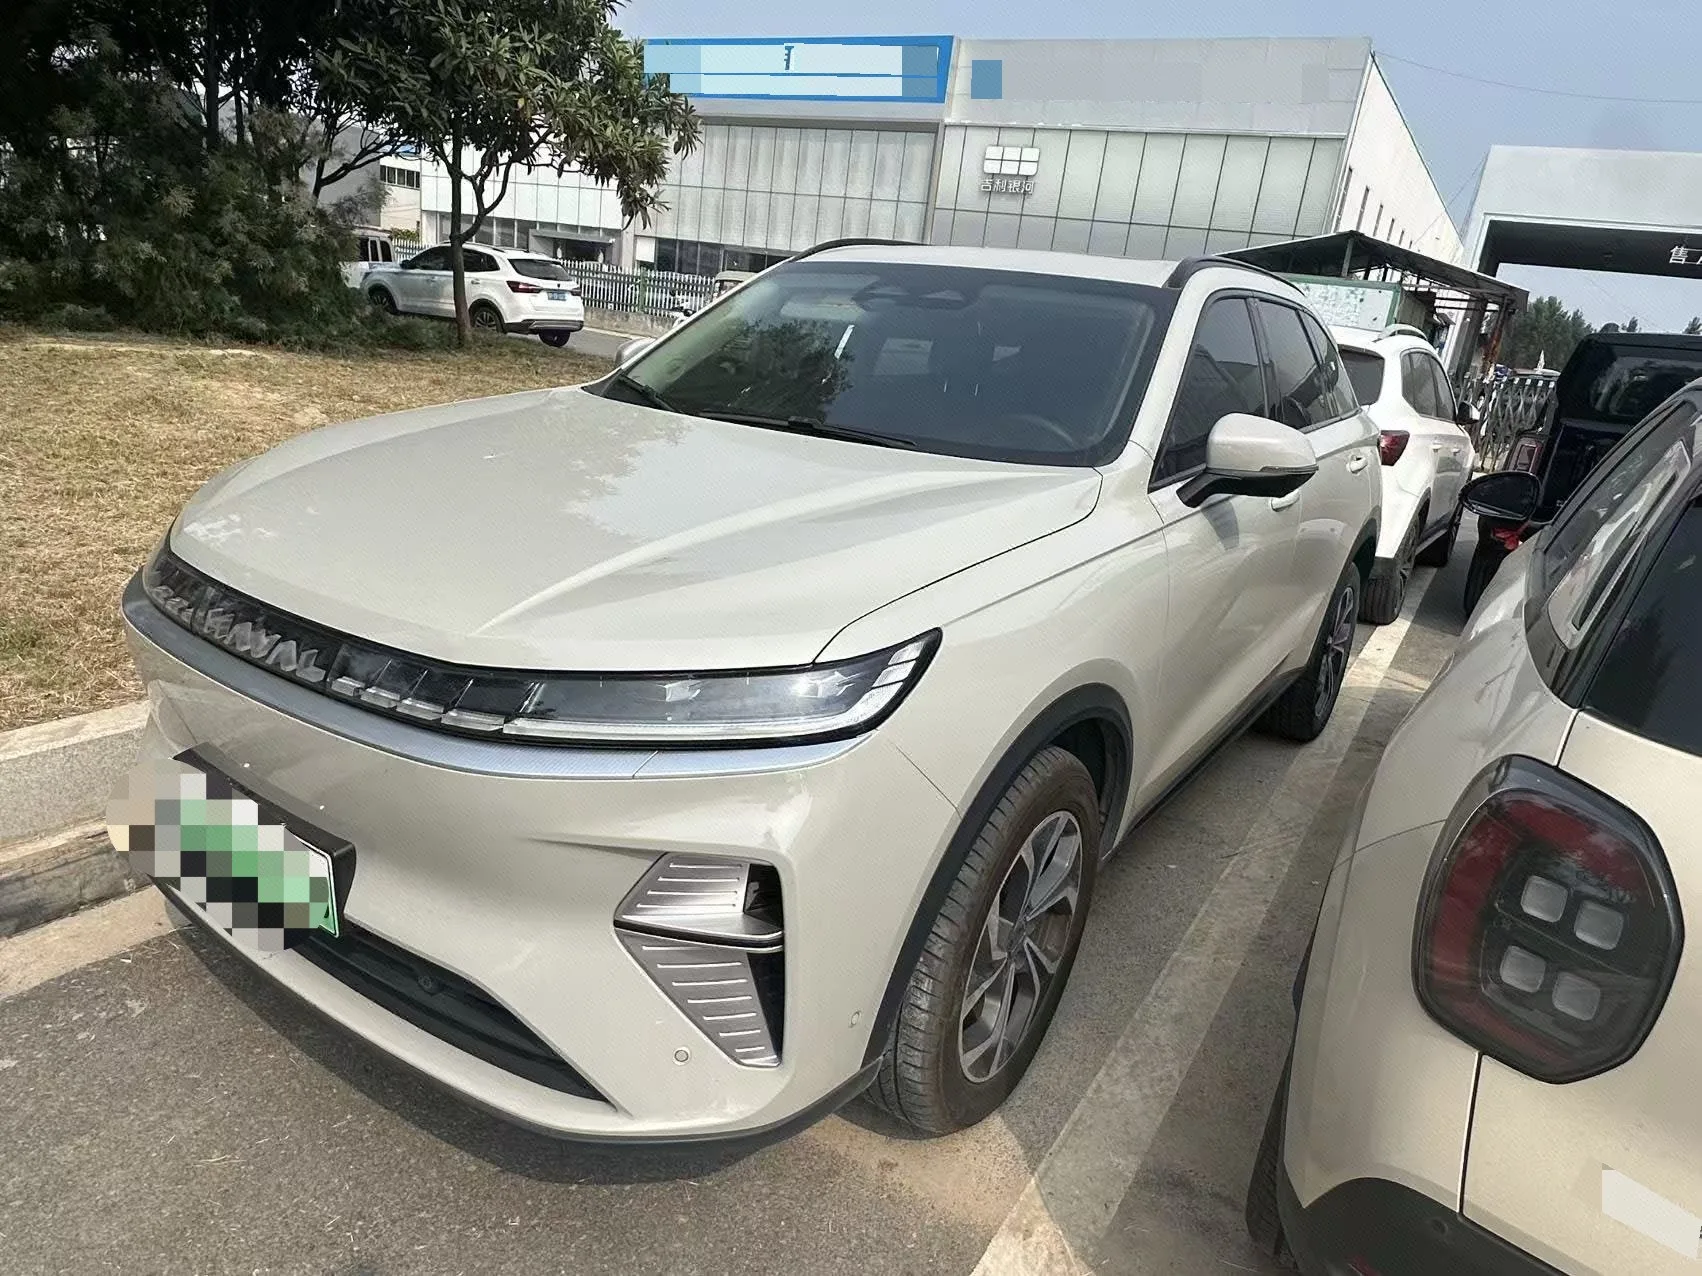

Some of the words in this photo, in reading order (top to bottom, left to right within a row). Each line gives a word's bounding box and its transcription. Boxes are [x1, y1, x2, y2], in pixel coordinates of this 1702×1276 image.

[981, 179, 1034, 194] 吉利银河
[1669, 245, 1702, 265] 售
